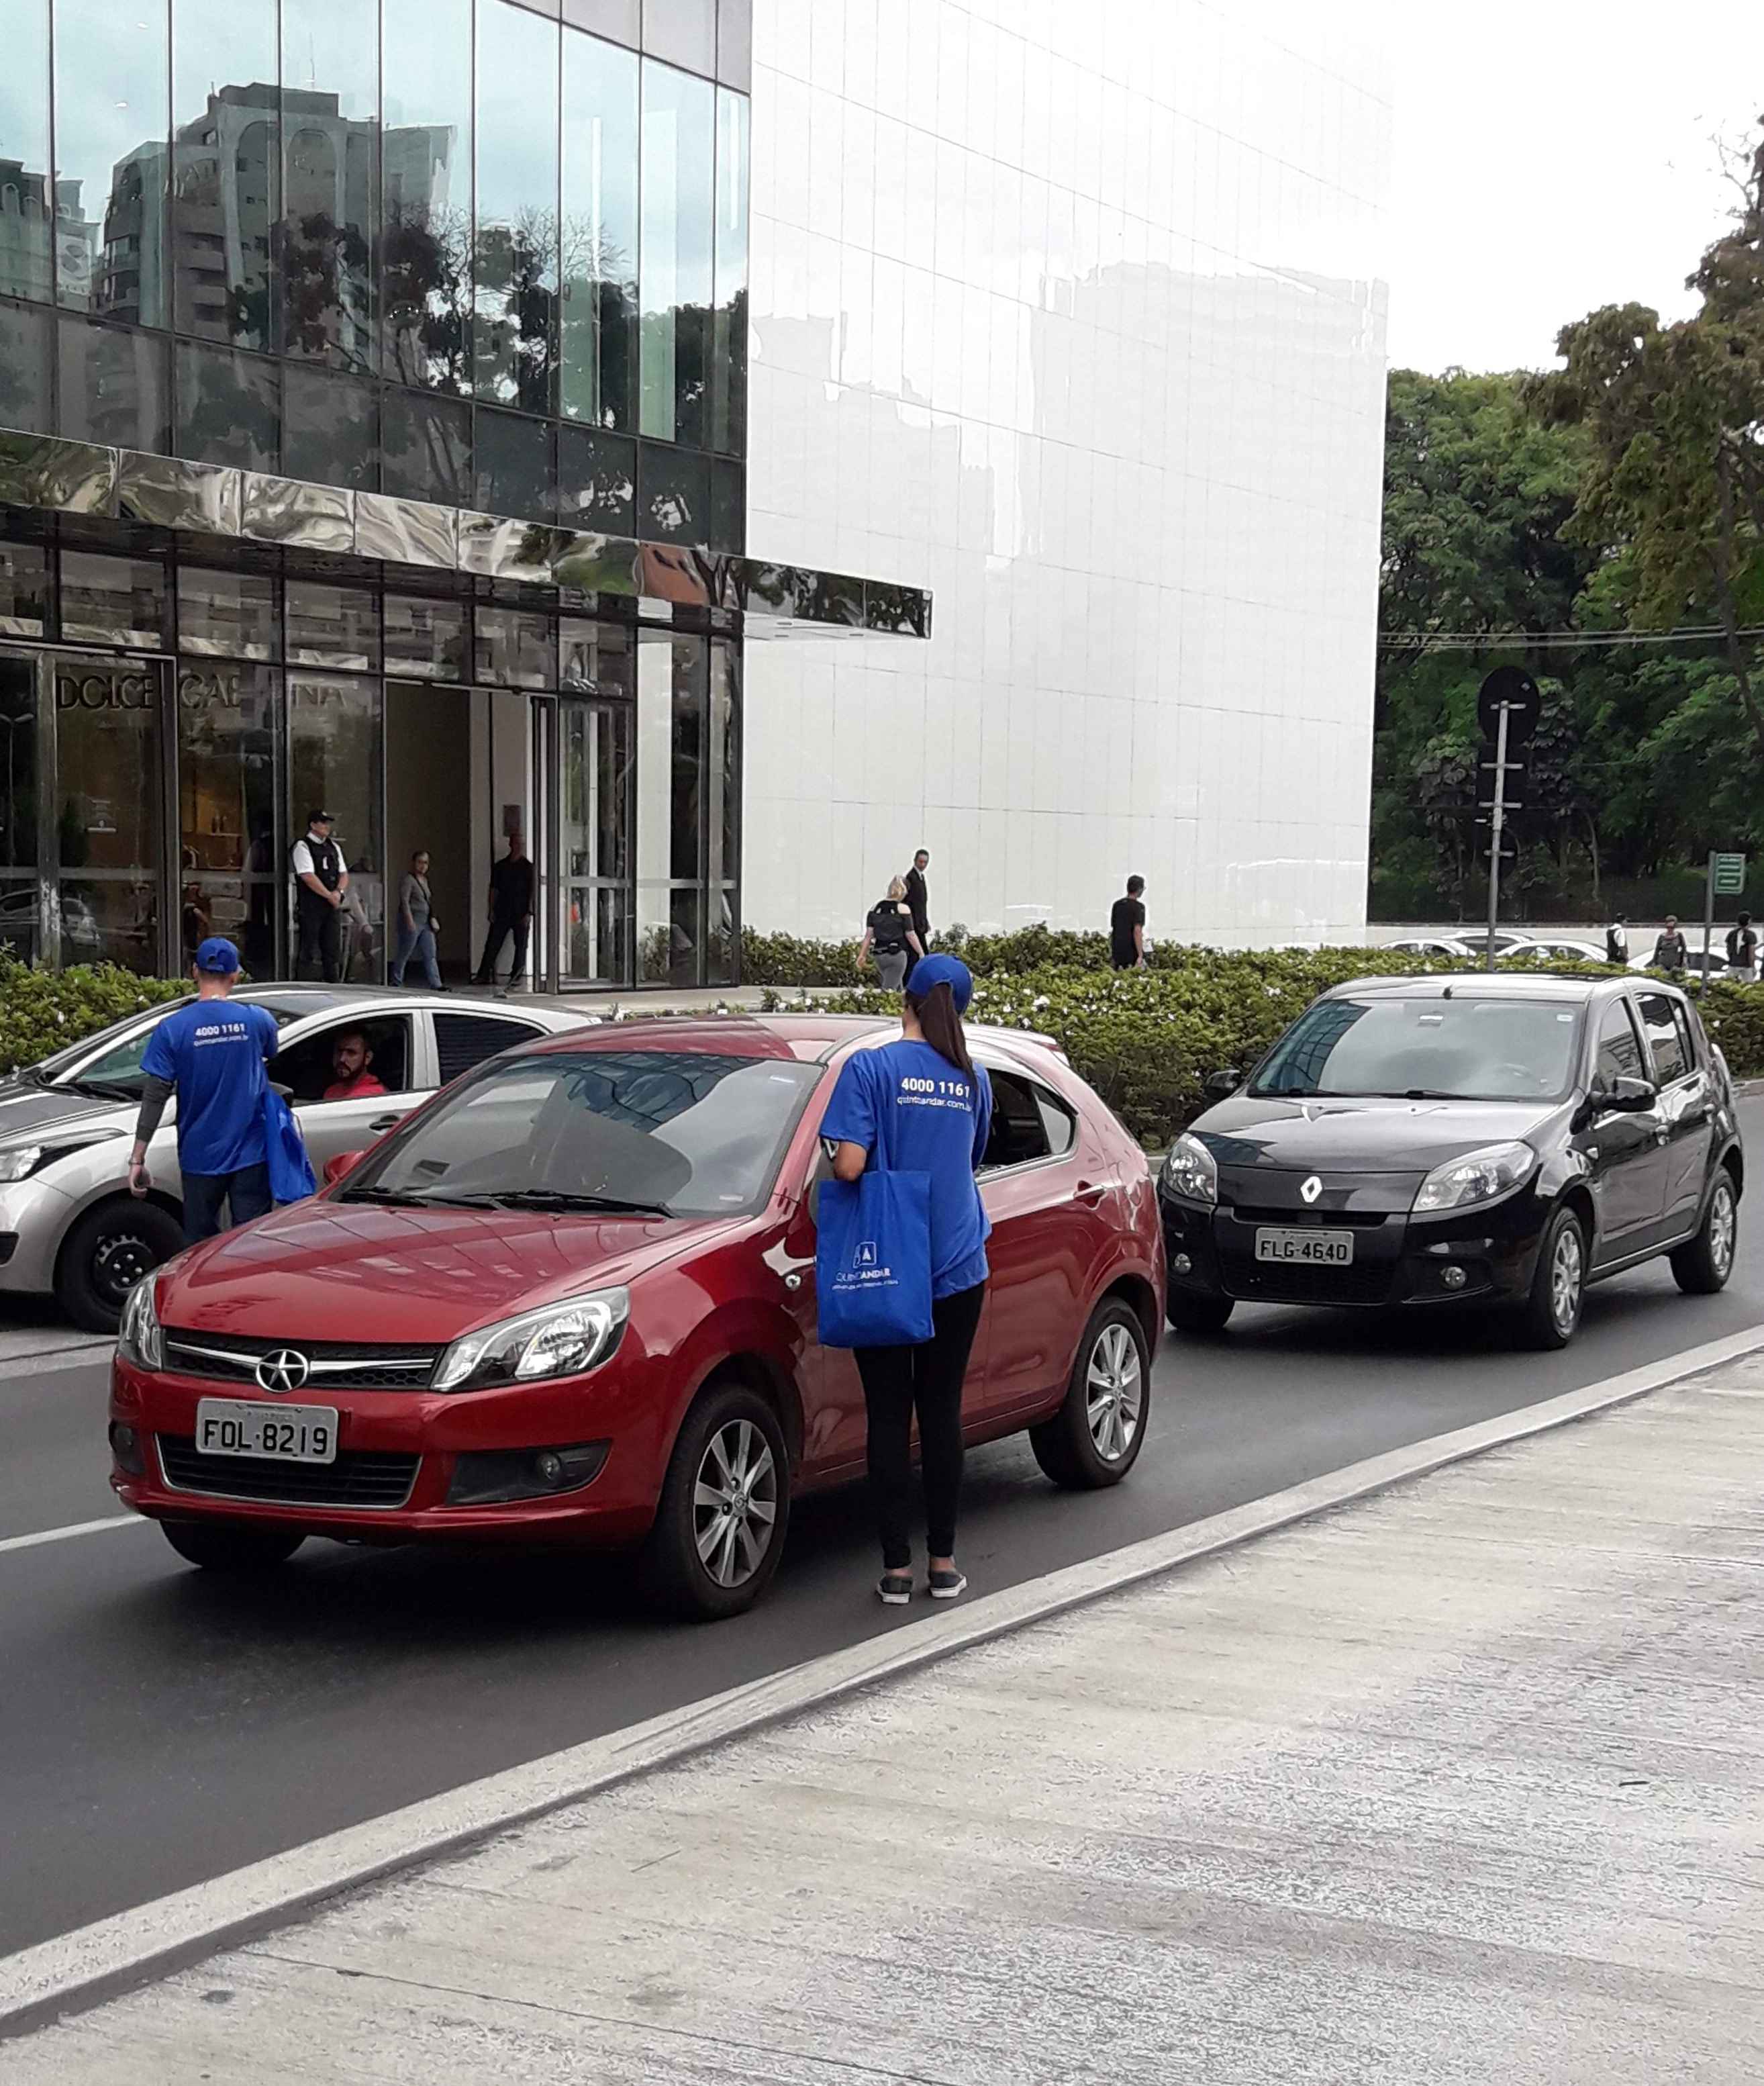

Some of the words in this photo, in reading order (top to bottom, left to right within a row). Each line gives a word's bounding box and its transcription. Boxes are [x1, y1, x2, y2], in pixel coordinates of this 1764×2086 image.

[195, 1026, 219, 1036] 4000
[222, 1023, 245, 1033] 1161
[901, 1078, 935, 1093] 4000
[939, 1081, 970, 1098] 1161
[1261, 1240, 1348, 1260] FLG-4640
